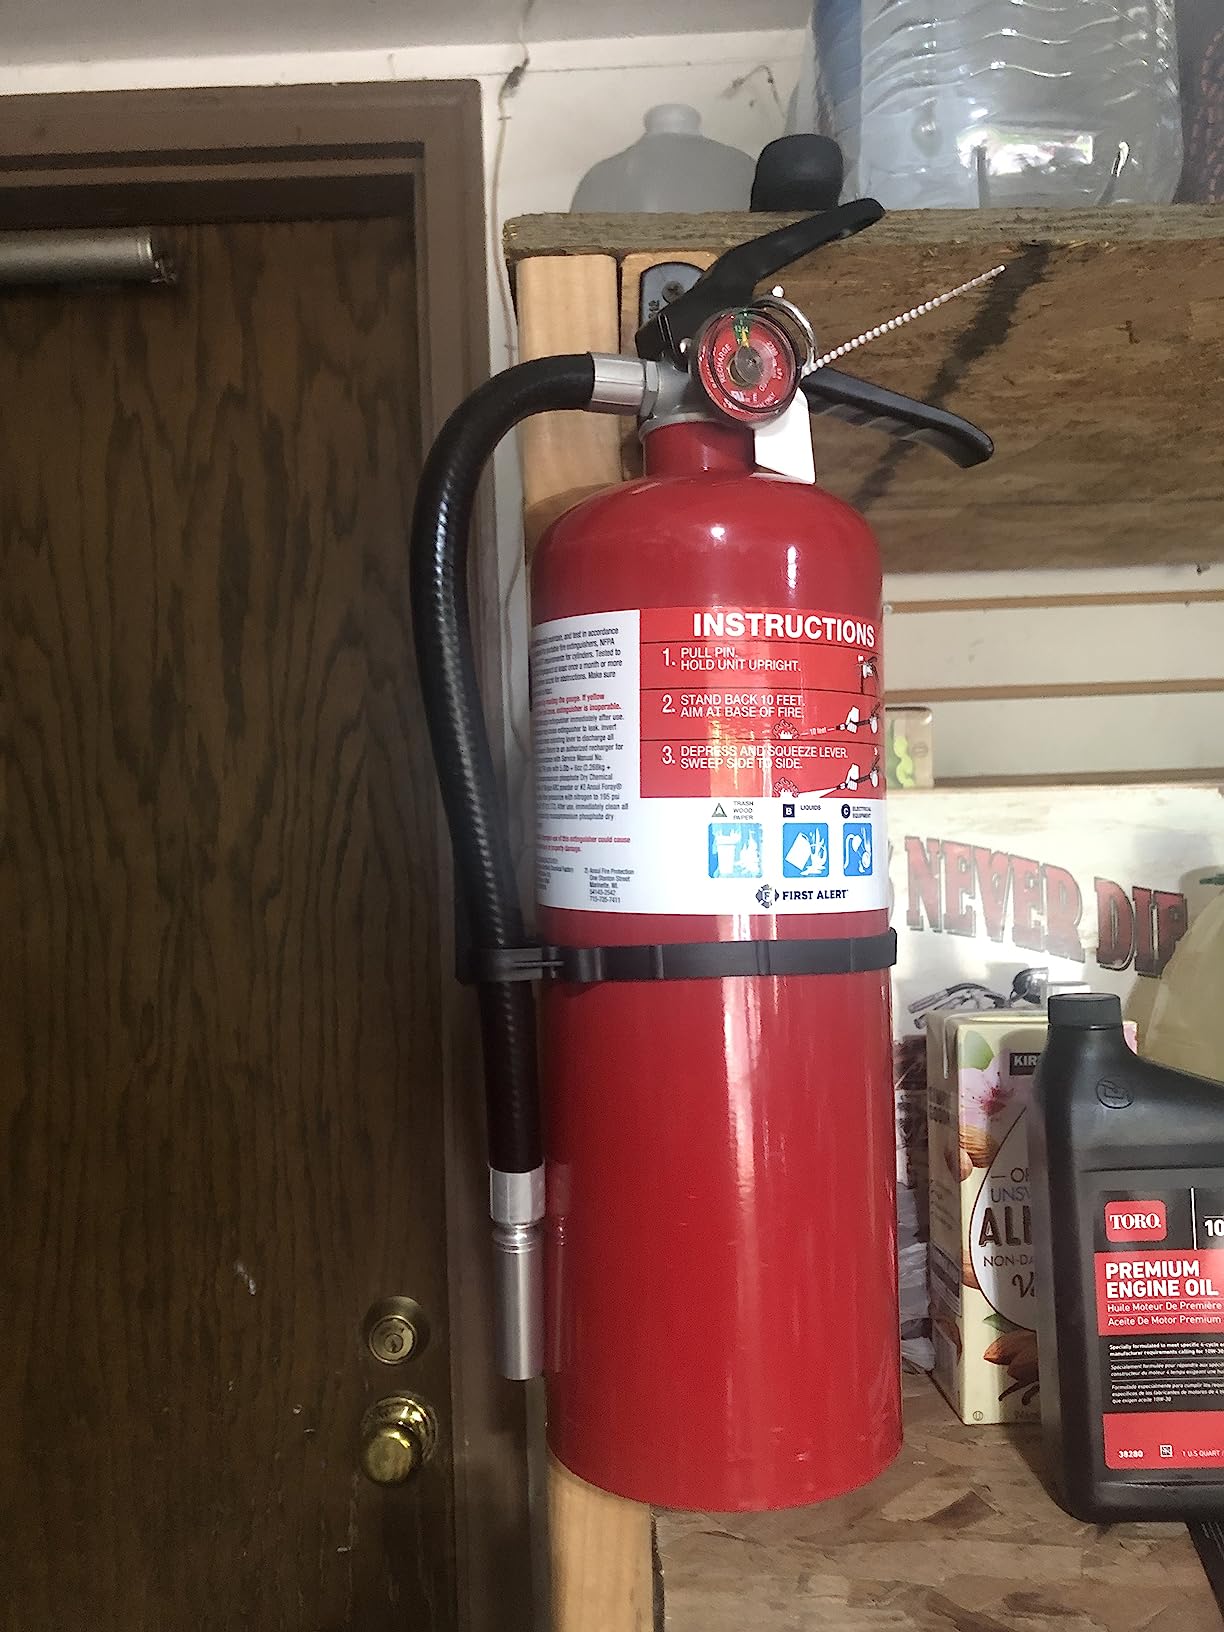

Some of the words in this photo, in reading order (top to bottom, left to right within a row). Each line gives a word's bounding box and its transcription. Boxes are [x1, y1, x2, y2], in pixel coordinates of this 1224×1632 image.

[715, 344, 733, 384] RECHARGE
[588, 627, 619, 637] accordance
[693, 612, 875, 648] INSTRUCTIONS
[600, 637, 615, 646] NFPA
[595, 649, 614, 657] Tested
[662, 647, 676, 667] 1.
[681, 647, 712, 659] PULL
[715, 647, 738, 659] PIN.
[583, 661, 600, 669] month
[681, 659, 715, 671] HOLD
[717, 659, 747, 671] UNIT
[748, 659, 801, 672] UPRIGHT.
[588, 671, 602, 679] Make
[587, 693, 605, 702] yellow
[681, 694, 722, 706] STAND
[724, 694, 758, 705] BACK
[760, 694, 774, 705] 10
[776, 694, 805, 707] FEET.
[589, 702, 622, 712] inoperable.
[662, 694, 676, 714] 2.
[681, 706, 703, 718] AIM
[705, 706, 721, 718] AT
[724, 706, 756, 718] BASE
[759, 706, 775, 718] OF
[778, 707, 804, 719] FIRE.
[809, 727, 817, 736] 10
[817, 727, 827, 735] feet
[582, 734, 606, 742] discharge
[589, 744, 614, 752] recharger
[681, 746, 737, 758] DEPRESS
[739, 746, 766, 757] AND
[769, 746, 817, 758] SQUEEZE
[819, 747, 848, 759] LEVER.
[662, 745, 676, 764] 3.
[681, 758, 723, 769] SWEEP
[726, 758, 753, 769] SIDE
[756, 758, 773, 769] TO
[775, 758, 803, 769] SIDE.
[782, 890, 814, 900] FIRST
[816, 889, 848, 899] ALERT
[904, 835, 1086, 964] NEVER
[1014, 1055, 1039, 1066] KIR
[1105, 1260, 1200, 1280] PREMIUM
[1106, 1280, 1180, 1299] ENGINE
[1184, 1279, 1219, 1296] OIL
[1107, 1303, 1131, 1312] Huile
[1132, 1302, 1163, 1311] Moteur
[1165, 1301, 1178, 1310] De
[1180, 1301, 1222, 1310] Première
[1108, 1317, 1135, 1326] Aceite
[1137, 1316, 1149, 1325] De
[1151, 1315, 1177, 1324] Motor
[1179, 1314, 1222, 1323] Premium
[1109, 1343, 1132, 1351] Specially
[1143, 1349, 1177, 1357] requirements
[1118, 1450, 1144, 1458] 38280
